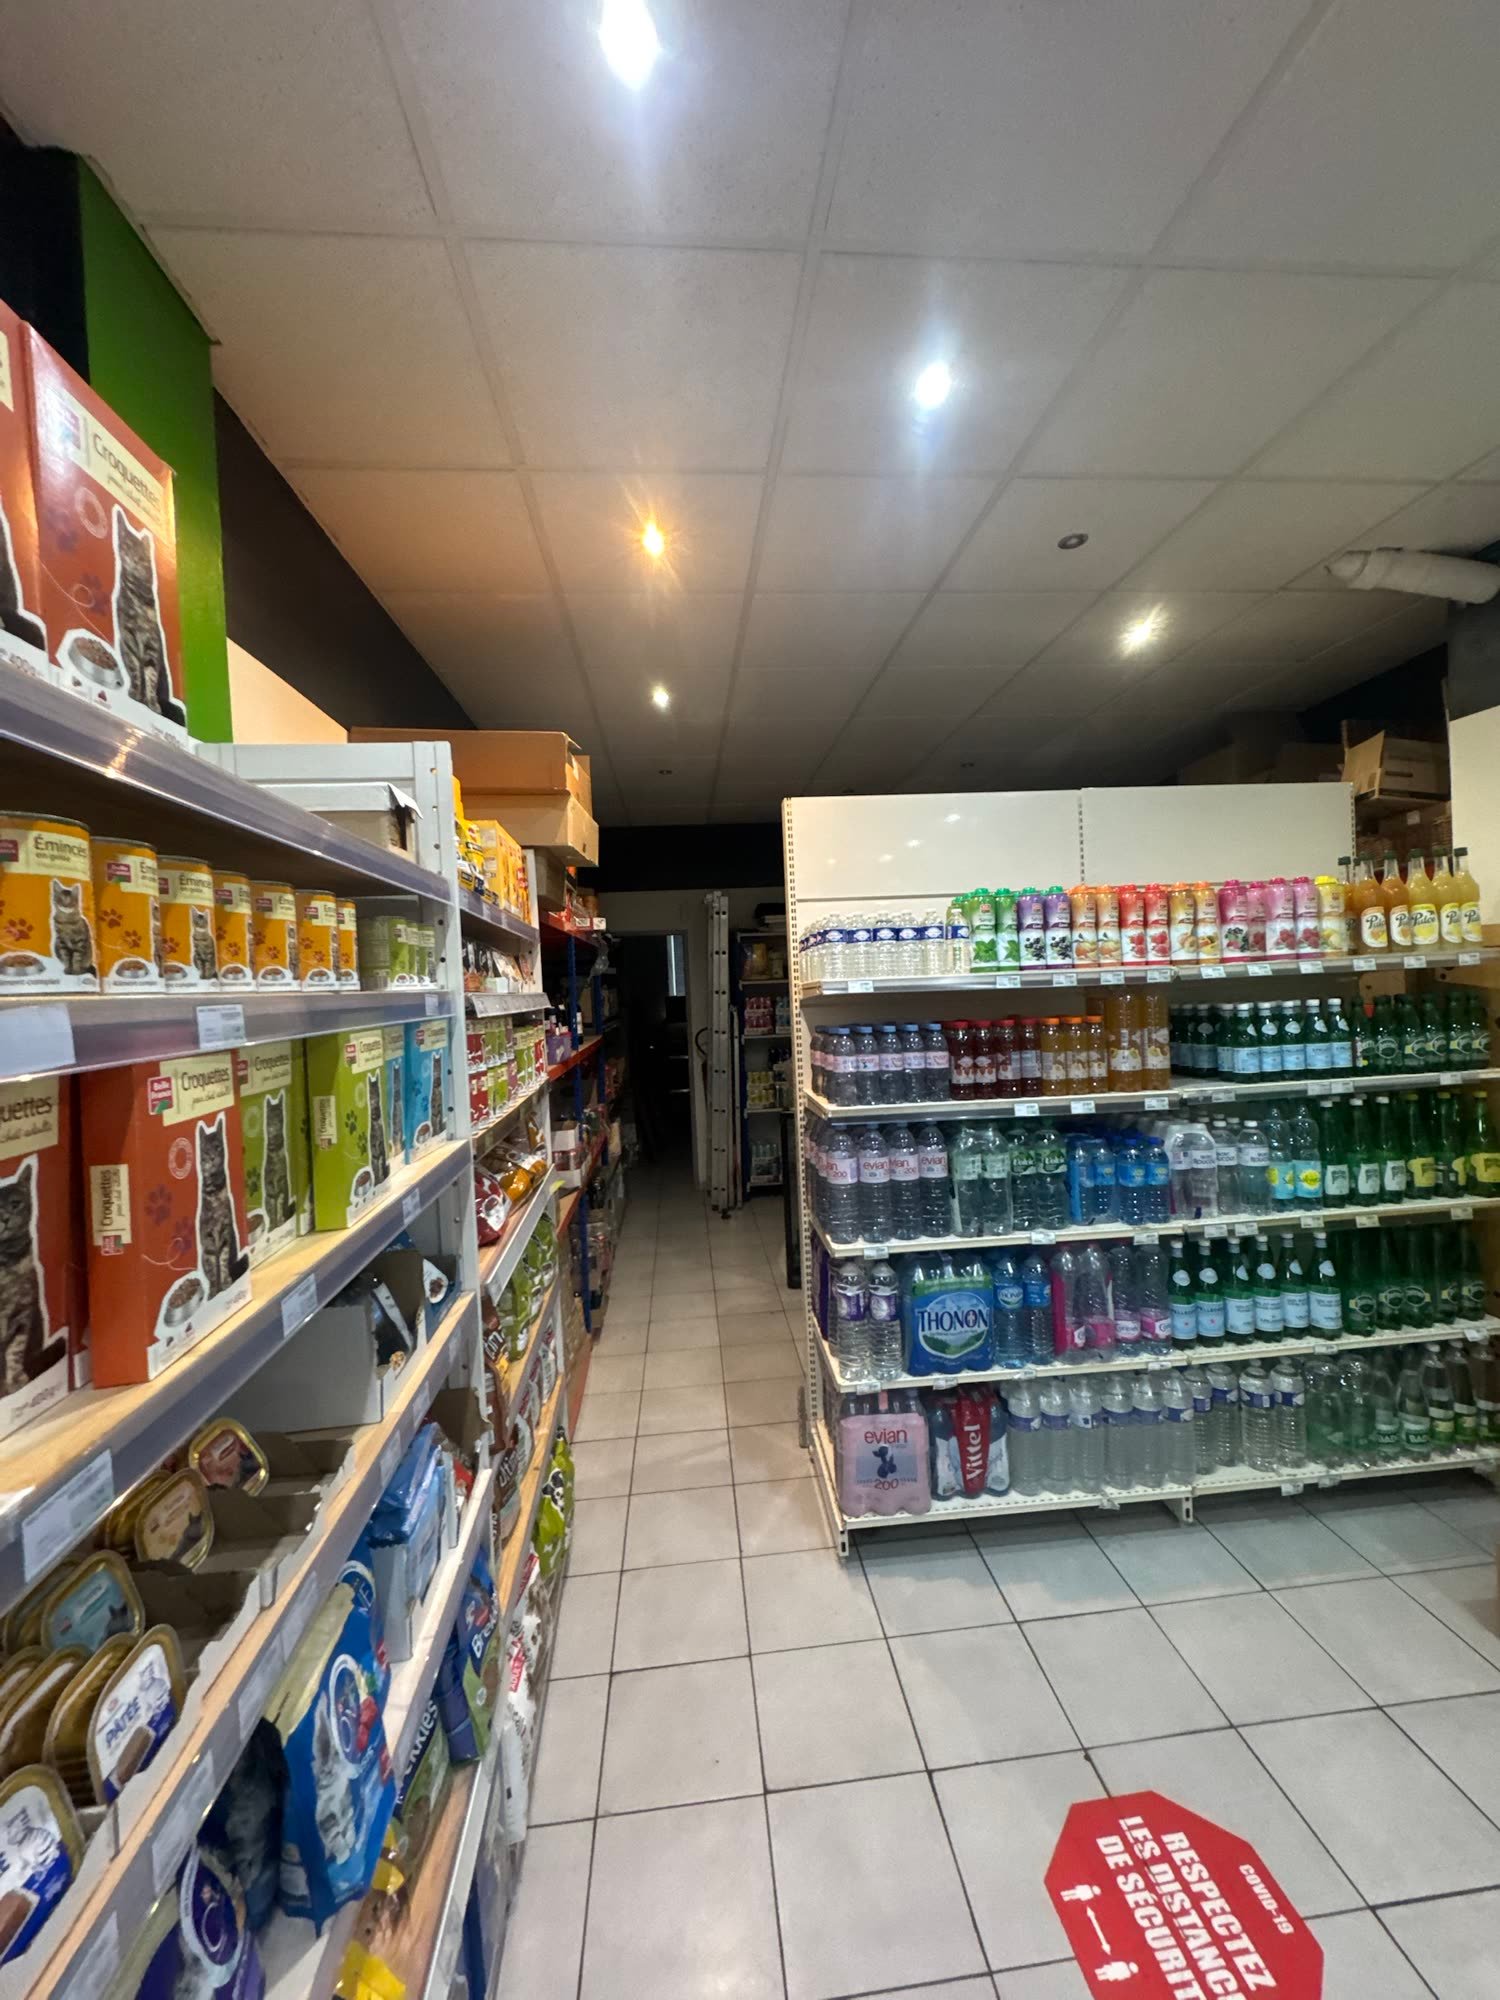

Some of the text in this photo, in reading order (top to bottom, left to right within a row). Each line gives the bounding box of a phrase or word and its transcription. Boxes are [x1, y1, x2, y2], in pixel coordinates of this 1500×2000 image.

[1411, 910, 1436, 927] Pulco
[181, 1067, 230, 1092] Croquettes
[863, 1159, 889, 1170] evian
[921, 1154, 946, 1165] evian
[101, 1169, 114, 1227] Croquettes
[916, 1308, 989, 1333] THONON
[864, 1427, 908, 1445] evian
[963, 1423, 984, 1481] Vittel
[873, 1477, 899, 1491] 200
[104, 1695, 142, 1748] PÂTÉE
[1095, 1834, 1135, 1870] DE
[1118, 1815, 1162, 1860] LES
[1160, 1831, 1277, 1992] RESPECTEZ
[1238, 1863, 1295, 1935] COVID-19
